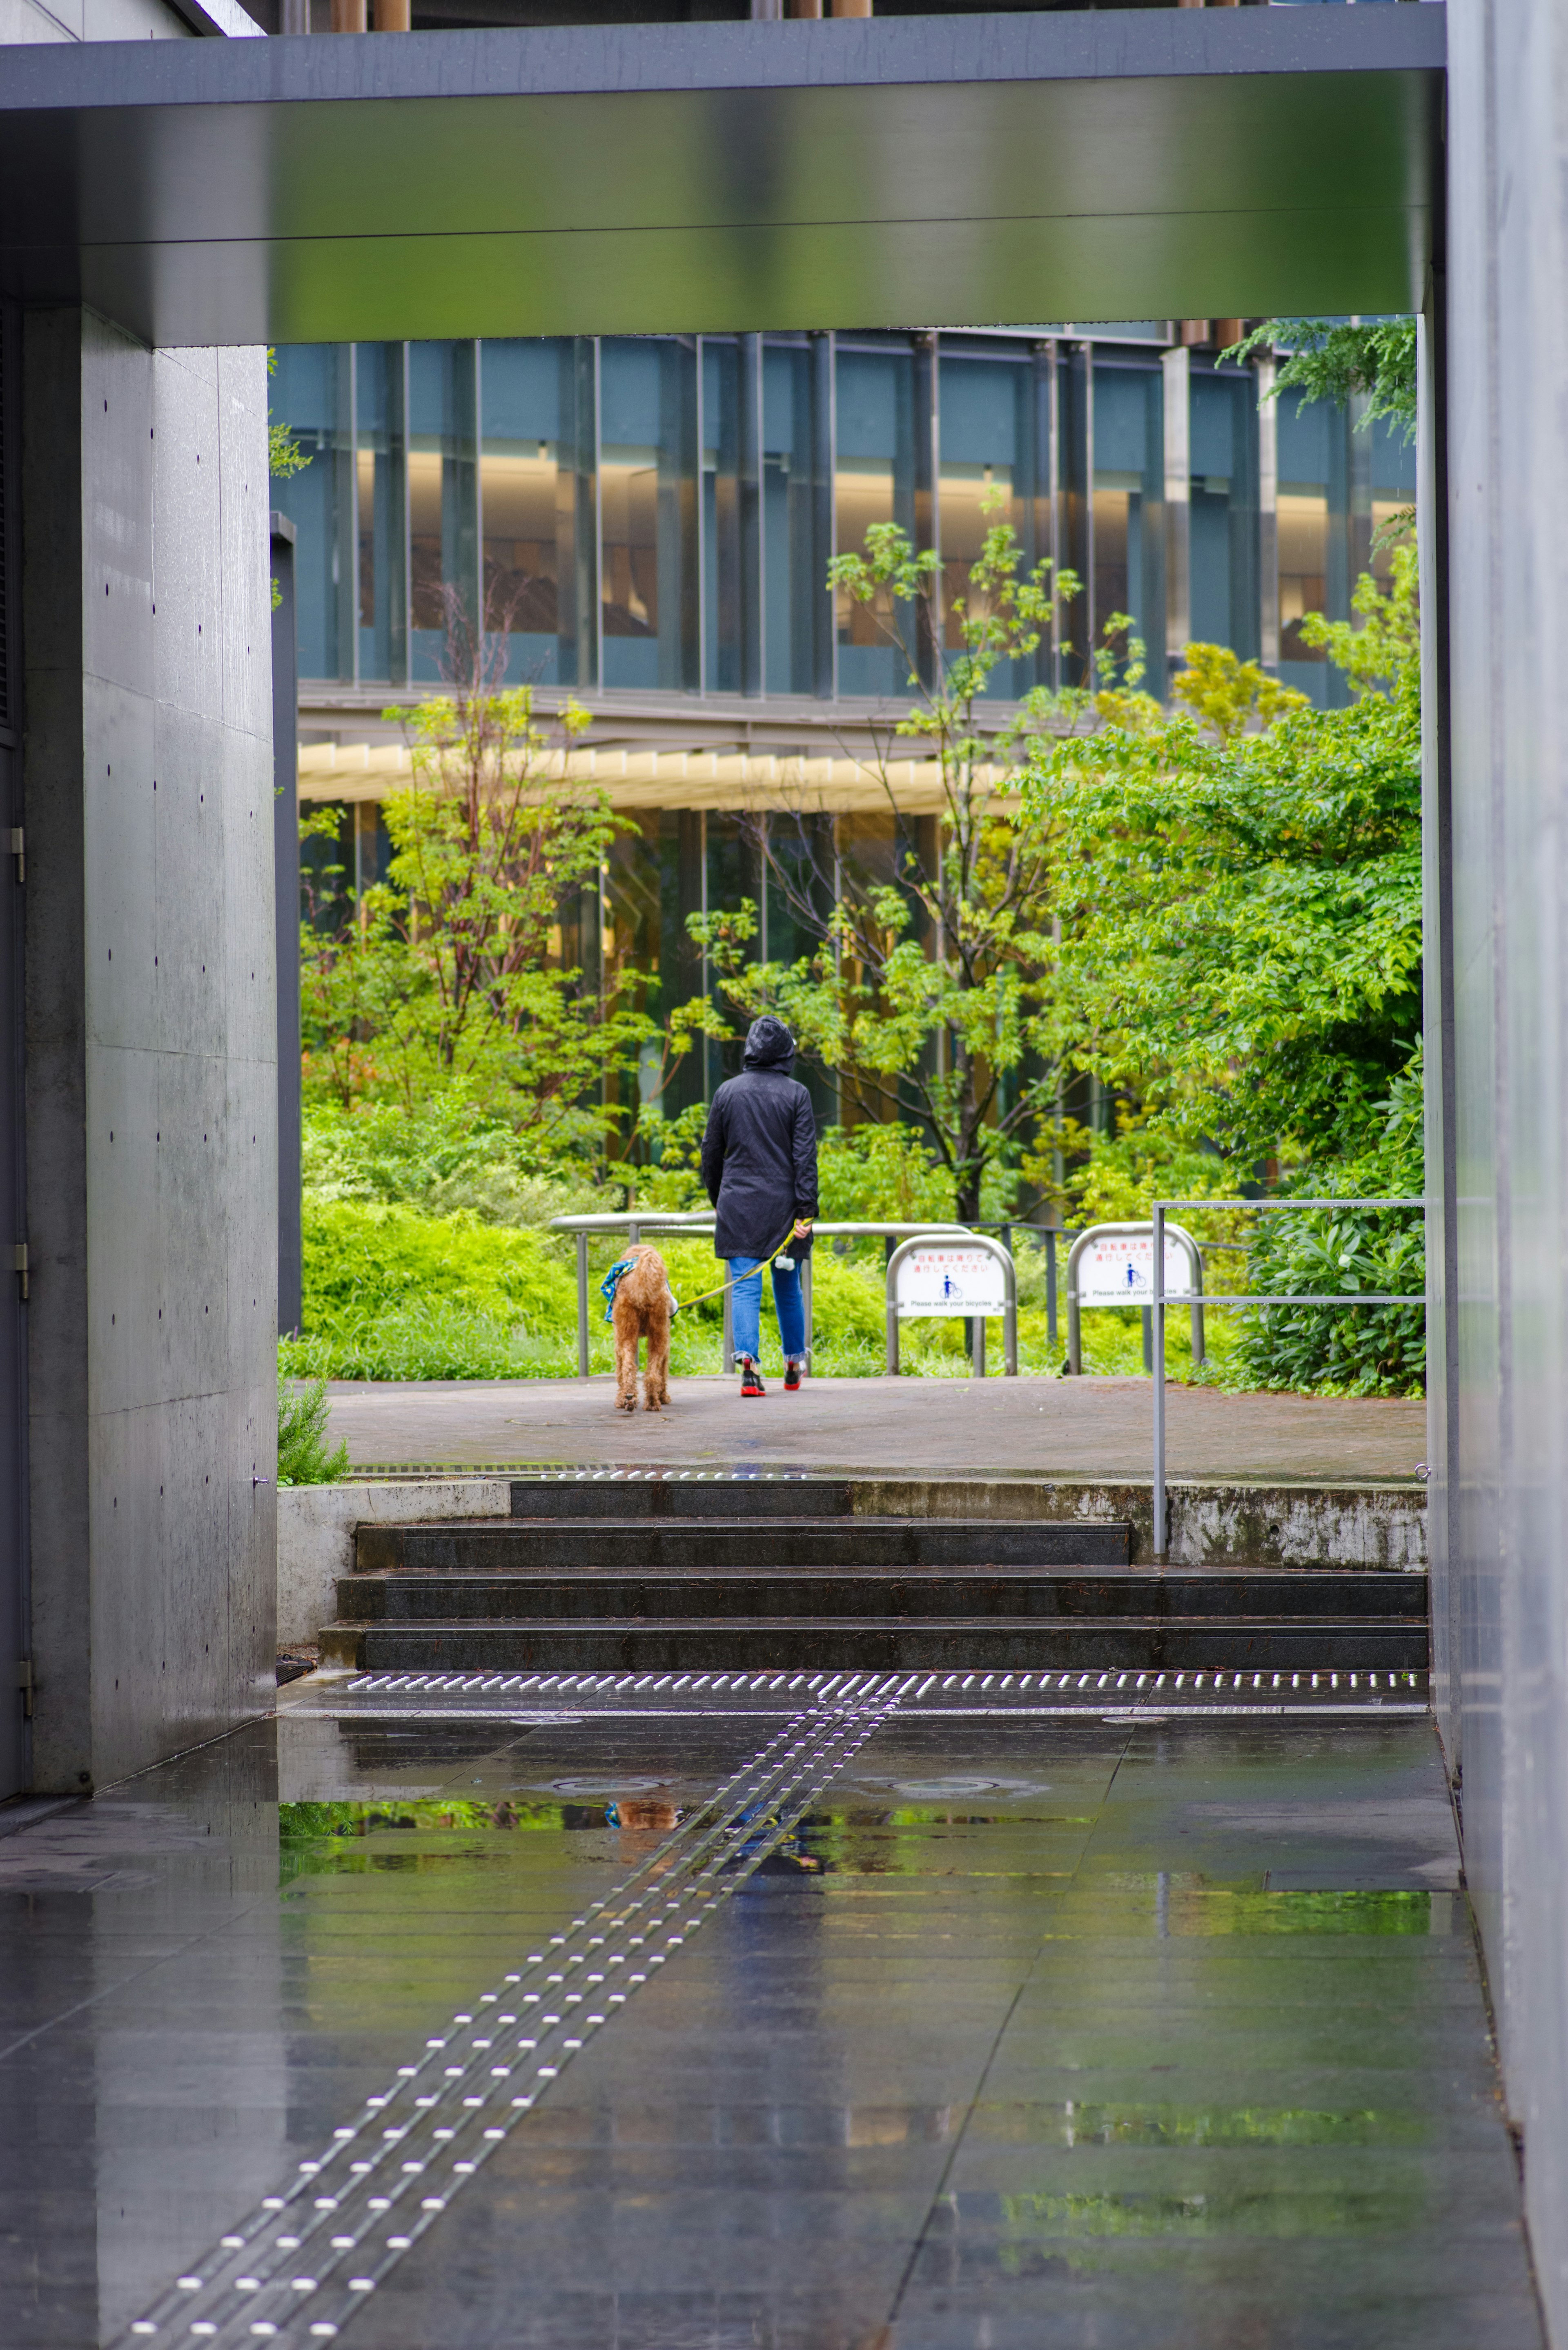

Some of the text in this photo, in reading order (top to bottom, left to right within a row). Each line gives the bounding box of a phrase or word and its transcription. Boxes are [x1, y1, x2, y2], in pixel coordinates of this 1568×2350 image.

[918, 1254, 983, 1263] 自転車は降りて
[1096, 1252, 1173, 1262] 通行してくだい
[913, 1264, 988, 1273] 通行してください
